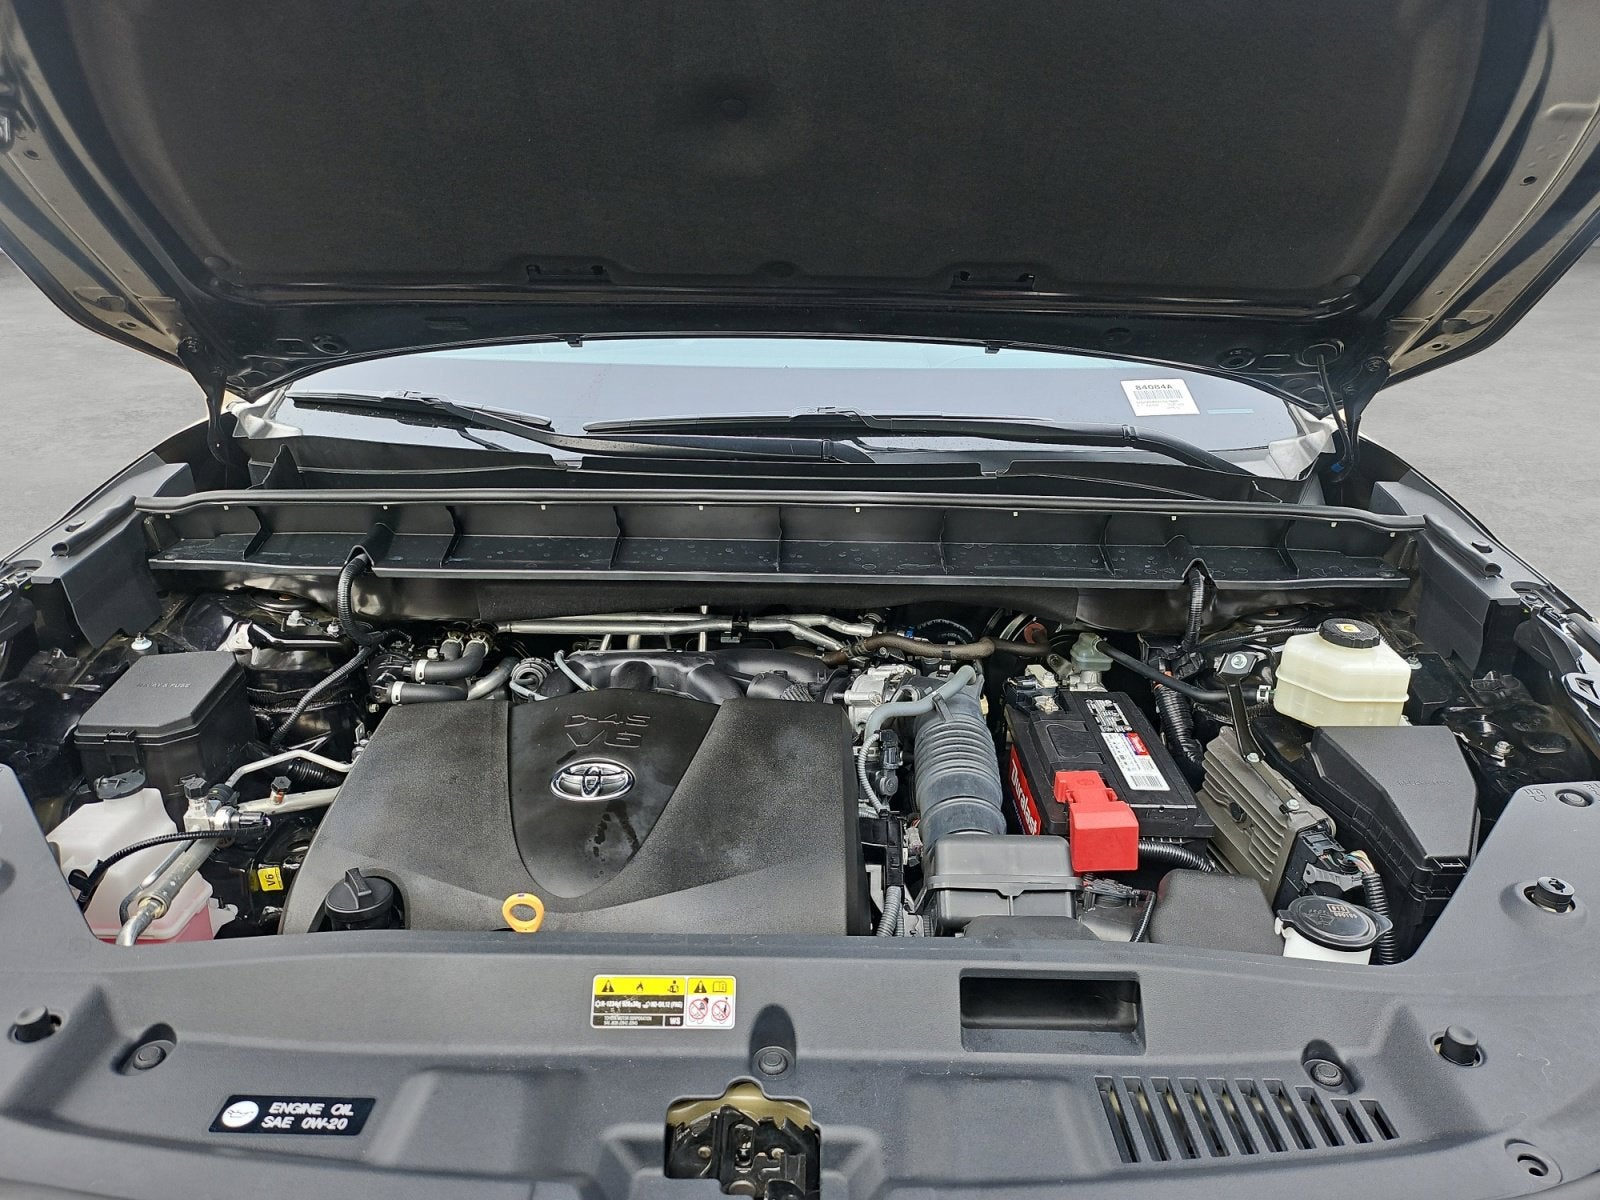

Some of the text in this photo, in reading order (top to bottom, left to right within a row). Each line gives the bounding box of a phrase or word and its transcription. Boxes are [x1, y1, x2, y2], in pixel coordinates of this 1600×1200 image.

[566, 729, 642, 748] V6
[1011, 758, 1037, 835] Duralast
[264, 874, 276, 886] V6
[669, 1017, 681, 1025] WS
[268, 1101, 355, 1116] ENGINE OIL
[261, 1116, 349, 1131] SAE 0W-20
